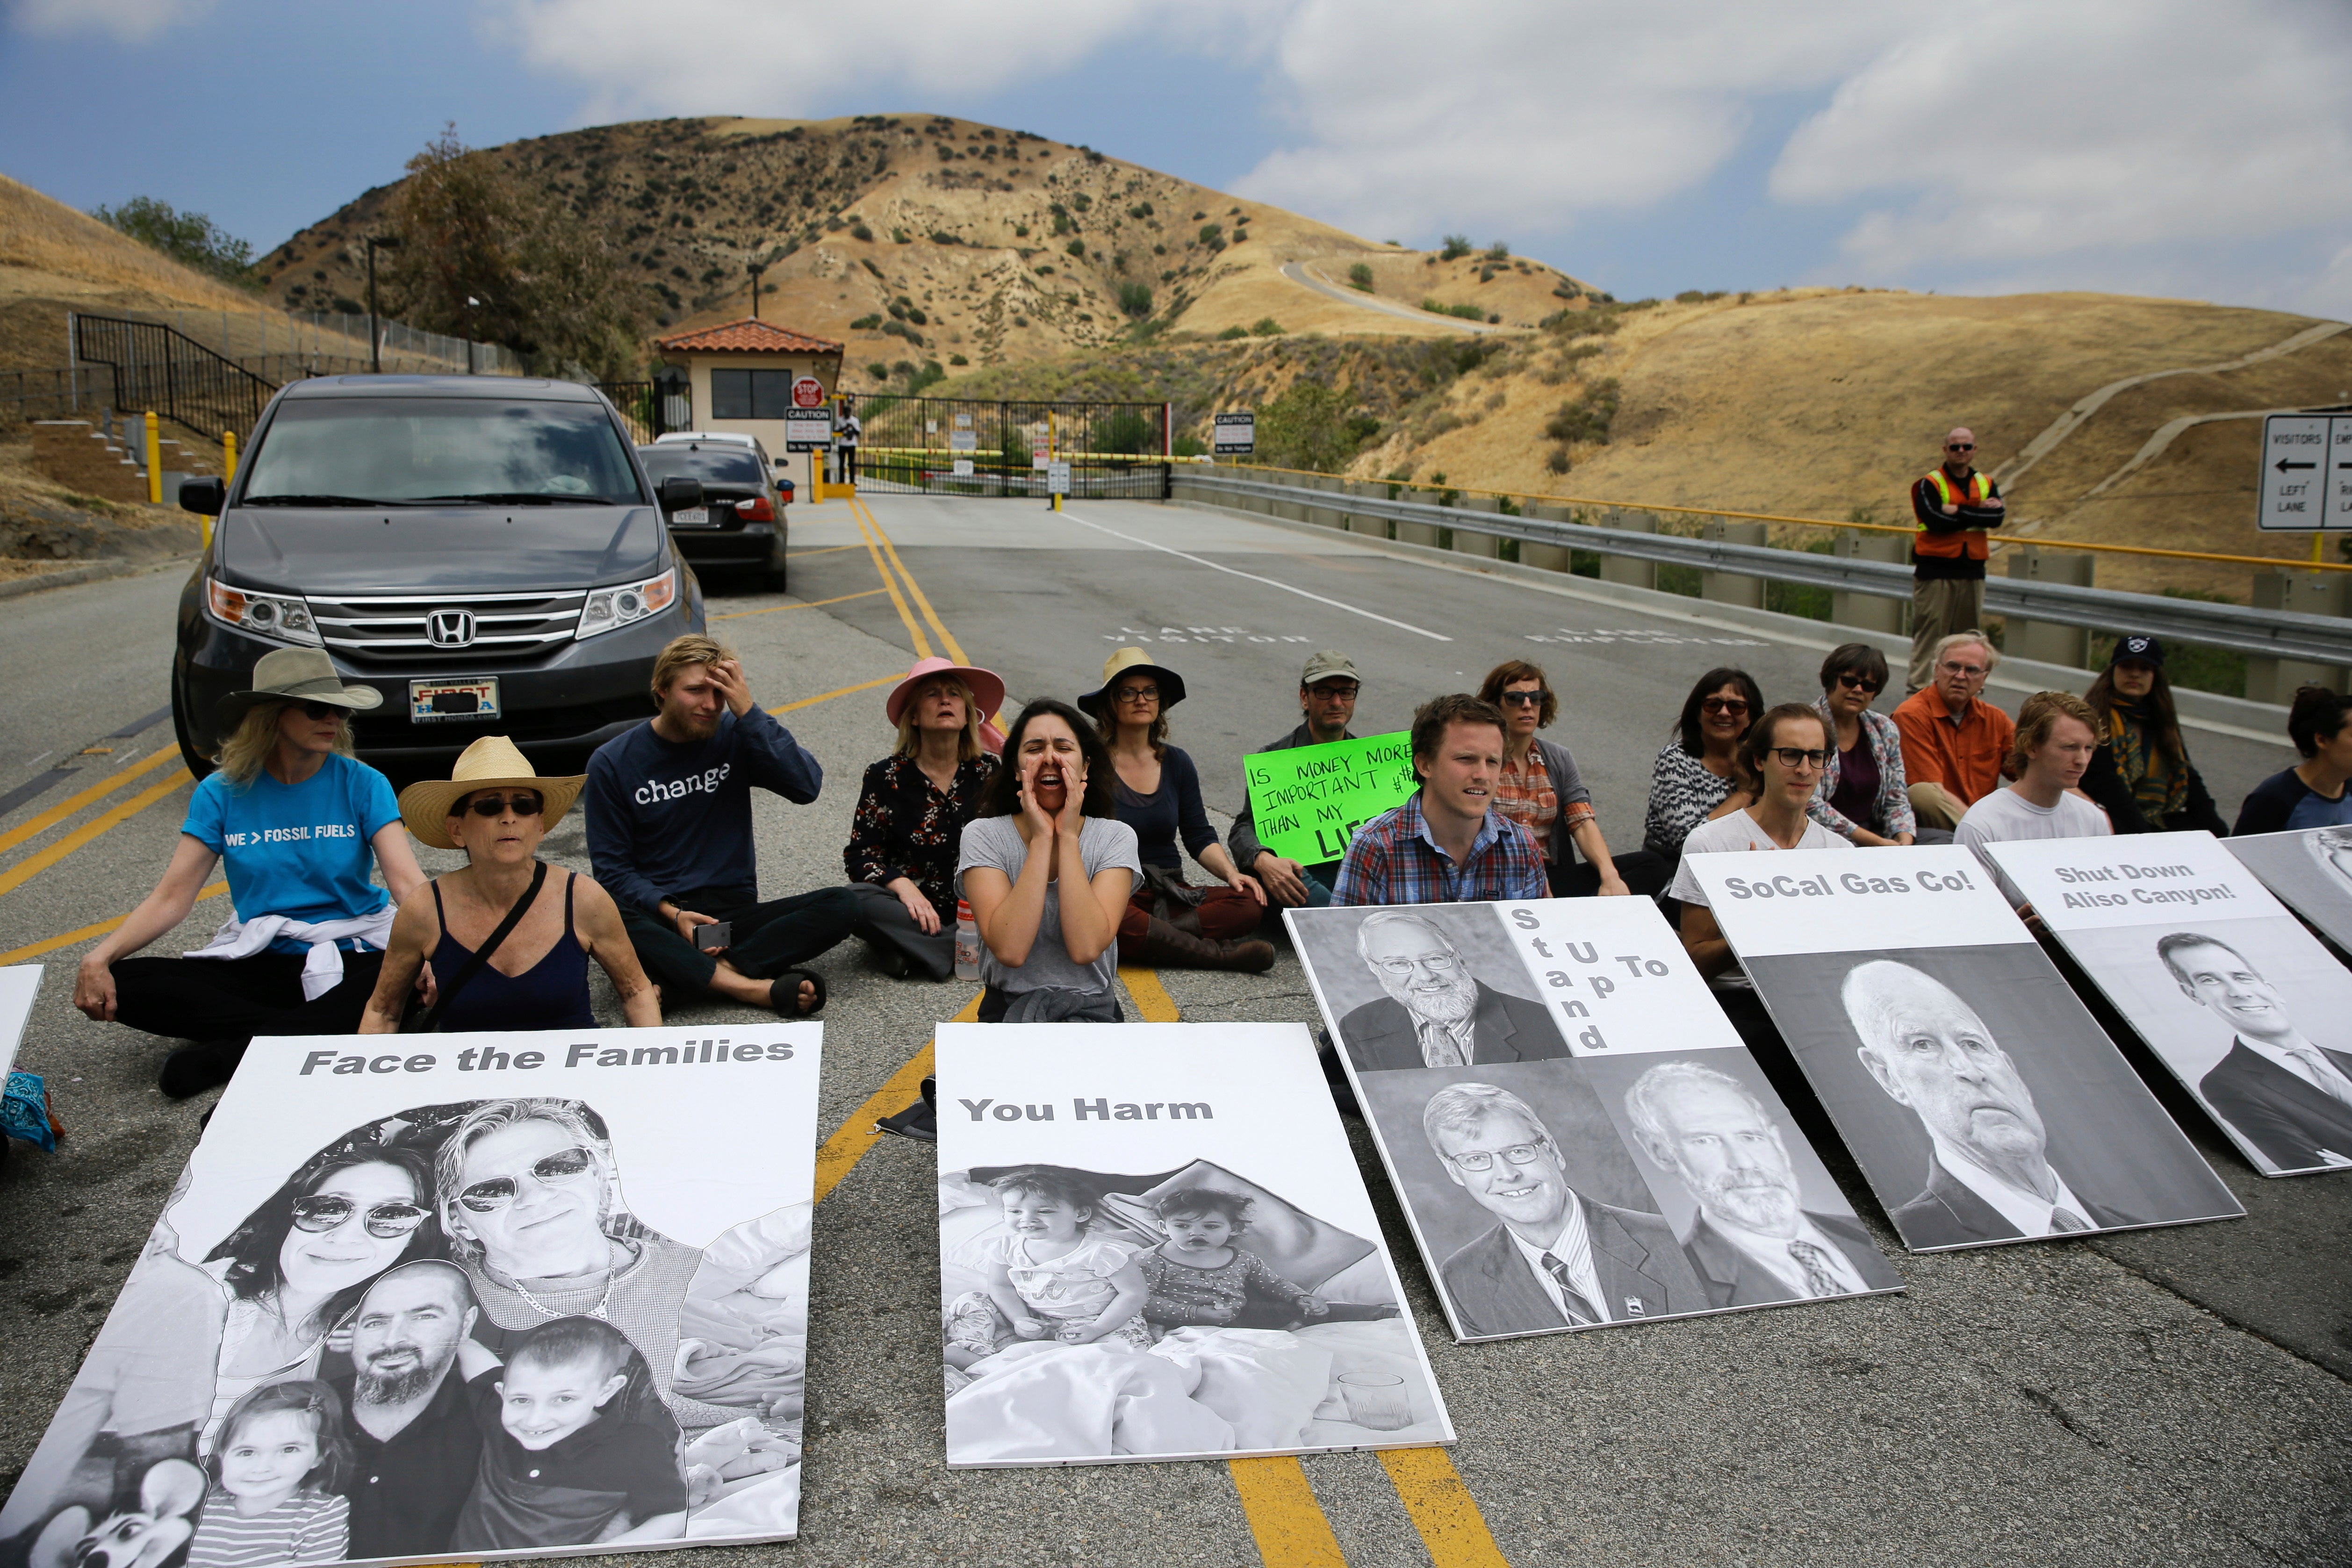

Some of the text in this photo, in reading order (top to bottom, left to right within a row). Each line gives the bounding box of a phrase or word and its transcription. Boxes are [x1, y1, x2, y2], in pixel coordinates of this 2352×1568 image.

[797, 383, 819, 395] STOP
[787, 410, 829, 420] CAUTION
[1216, 415, 1252, 424] CAUTION
[2273, 434, 2322, 445] VISITORS
[2279, 485, 2308, 496] LEFT
[2277, 502, 2307, 512] LANE
[1249, 742, 1412, 787] IS MONEY MORE
[635, 763, 730, 805] change
[1262, 769, 1379, 812] IMPORTANT
[1258, 803, 1343, 839] THAN MY
[225, 834, 246, 847] WE
[264, 827, 311, 842] FOSSIL
[315, 824, 355, 838] FUELS
[1725, 870, 1976, 899] SoCal Gas Co!
[2055, 864, 2195, 883] Shut Down
[2062, 883, 2237, 909] Aliso Canyon!
[1565, 942, 1615, 999] Up
[1614, 956, 1669, 978] To
[299, 1038, 794, 1076] Face the Families
[957, 1097, 1214, 1122] You Harm
